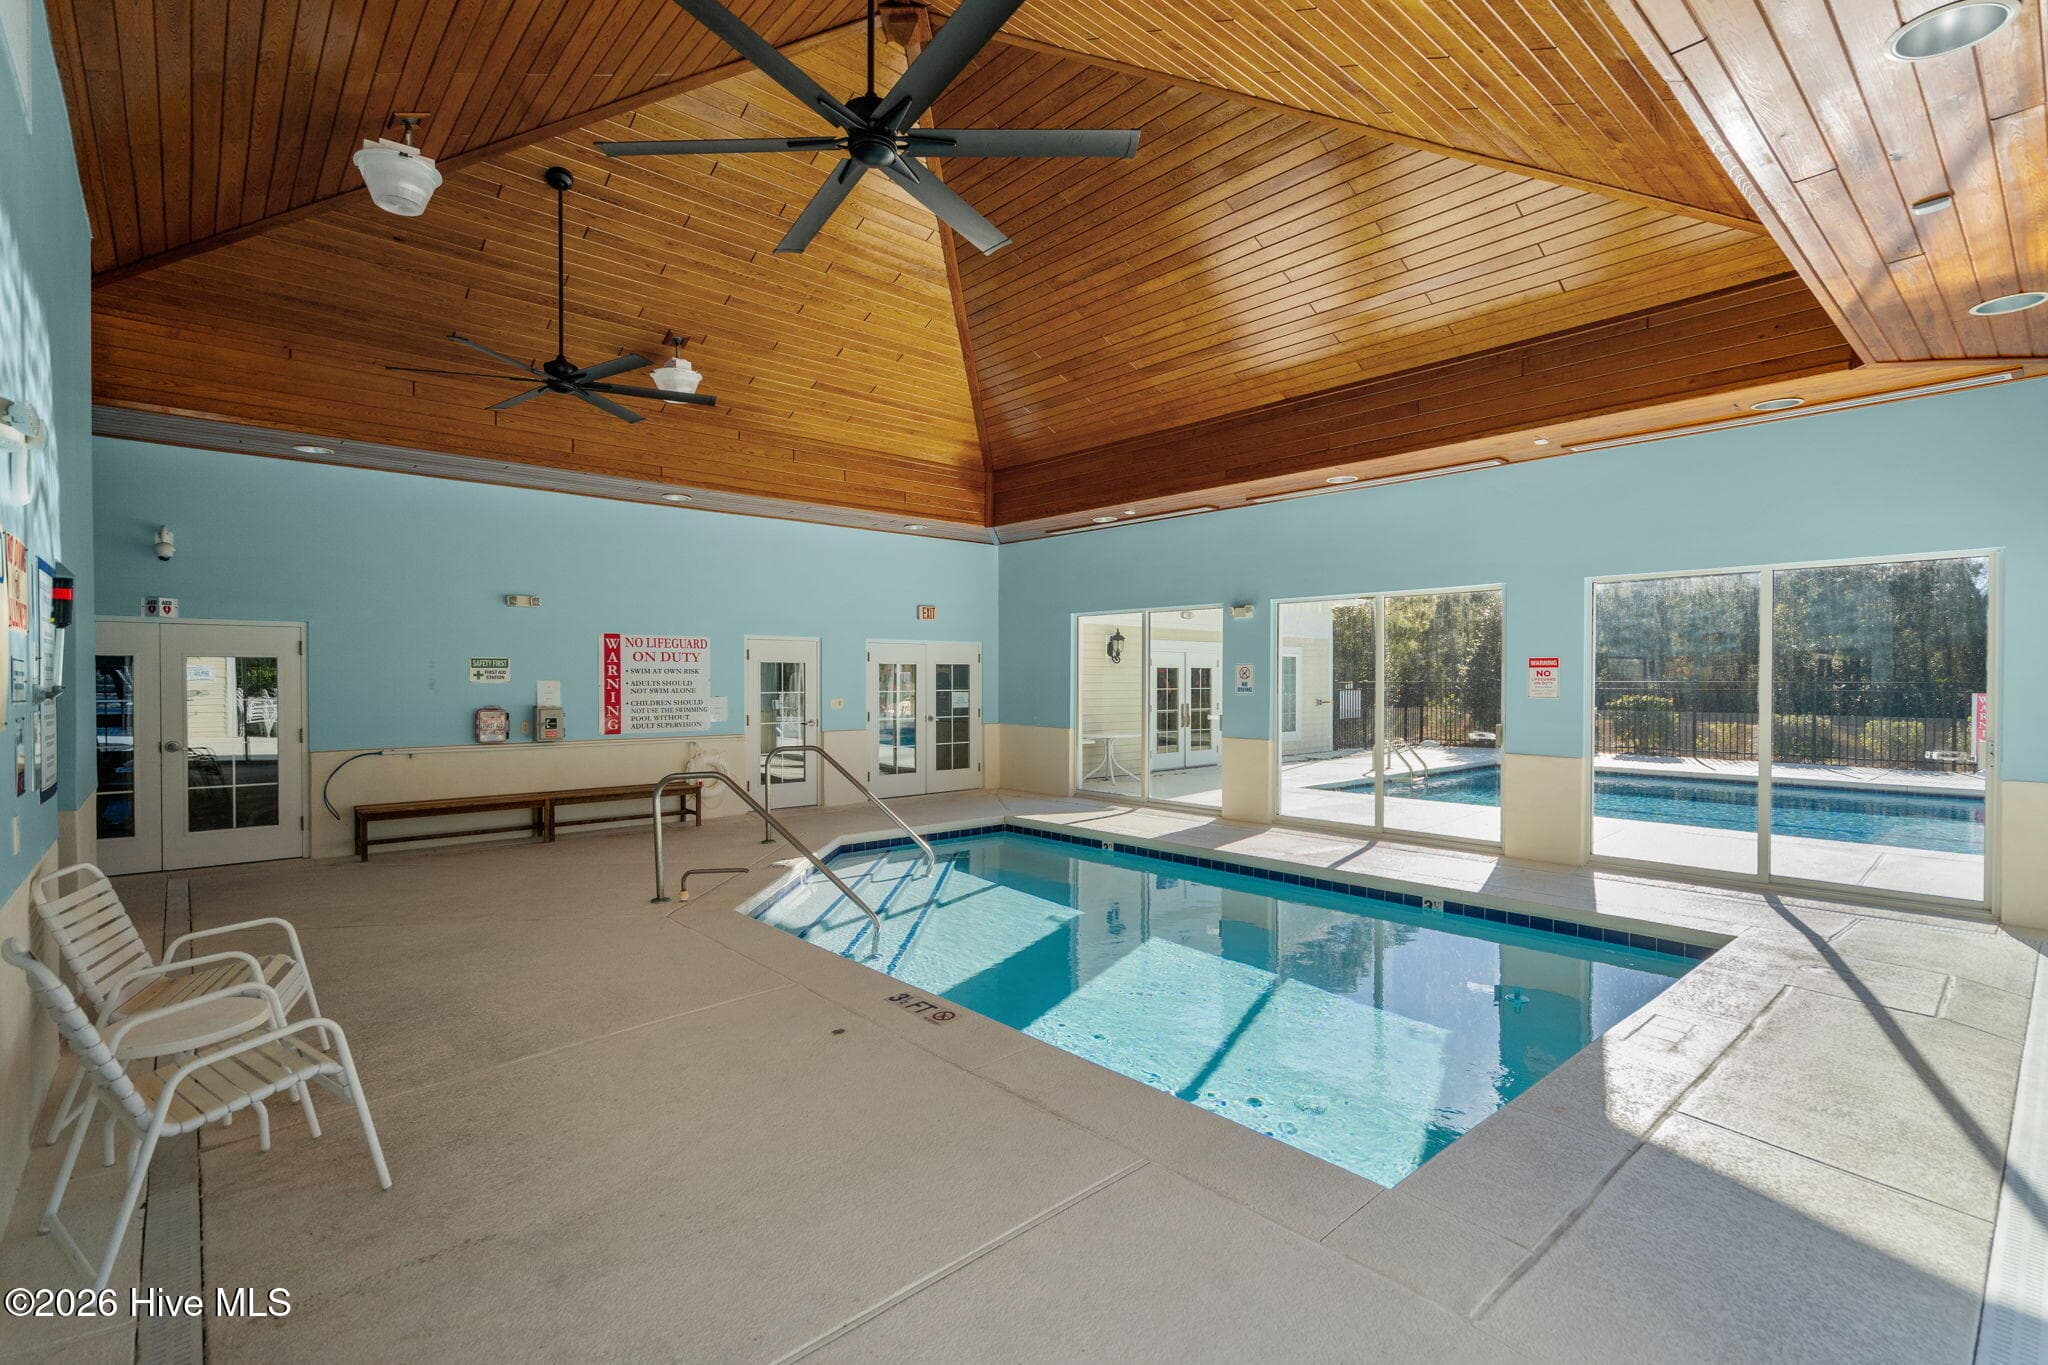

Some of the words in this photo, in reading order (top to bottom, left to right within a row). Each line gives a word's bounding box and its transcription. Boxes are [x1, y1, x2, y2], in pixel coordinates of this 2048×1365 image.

[922, 607, 935, 619] EXIT
[625, 637, 643, 648] NO
[646, 637, 708, 649] LIFEGUARD
[633, 651, 655, 662] ON
[661, 652, 700, 662] DUTY
[605, 638, 619, 730] WARNING
[905, 1001, 938, 1013] FT
